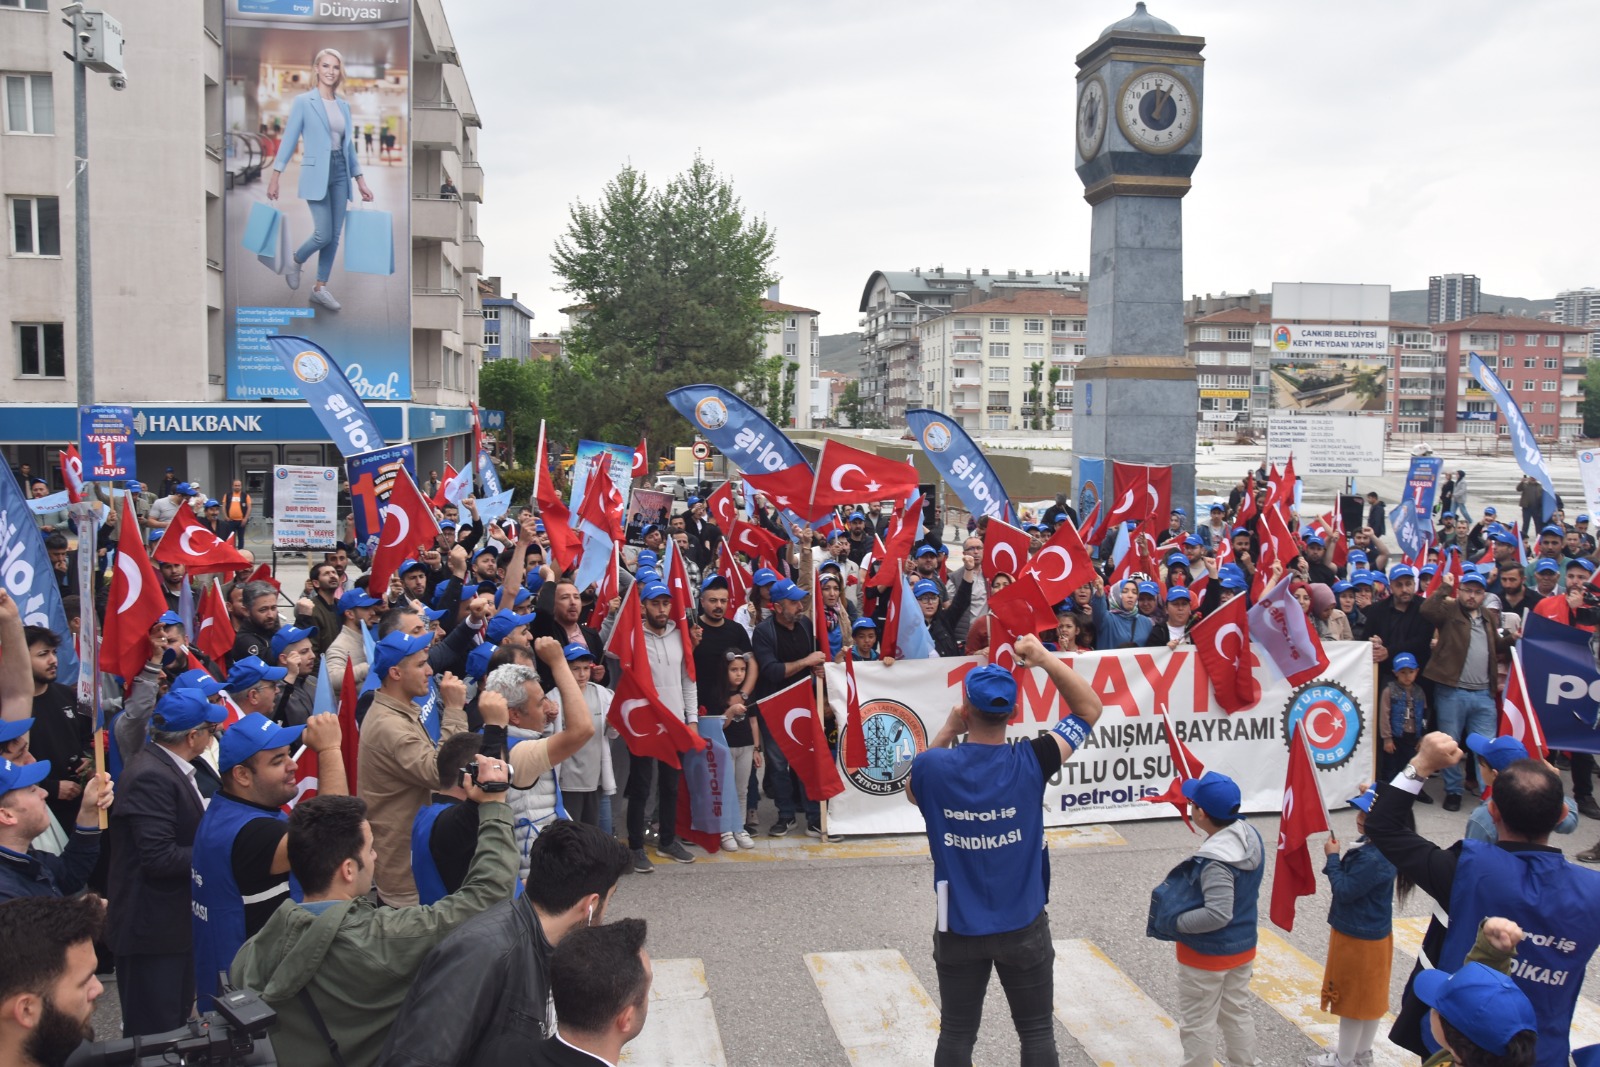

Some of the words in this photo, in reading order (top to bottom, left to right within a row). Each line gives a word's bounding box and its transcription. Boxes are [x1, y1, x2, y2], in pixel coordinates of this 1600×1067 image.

[293, 4, 310, 13] troy
[319, 3, 381, 21] Dünyası
[1141, 82, 1150, 90] 11
[1132, 91, 1141, 99] 10
[1301, 329, 1333, 337] ÇANKIRI
[1334, 330, 1377, 338] BELEDİYESİ
[1292, 339, 1313, 347] KENT
[1314, 340, 1349, 348] MEYDANI
[248, 387, 299, 396] HALKBANK
[149, 415, 262, 433] HALKBANK
[87, 435, 128, 443] YAŞASIN
[102, 442, 113, 466] 1
[361, 450, 401, 465] petrol-iş
[94, 466, 126, 476] Mayıs
[351, 472, 381, 535] 1
[1294, 689, 1352, 713] TÜRK-İŞ
[1175, 717, 1275, 743] BAYRAMI
[1048, 760, 1107, 787] UTLU
[855, 773, 892, 793] PETROL-İŞ
[943, 807, 1017, 821] petrol-iş
[943, 828, 1022, 850] SENDİKASI
